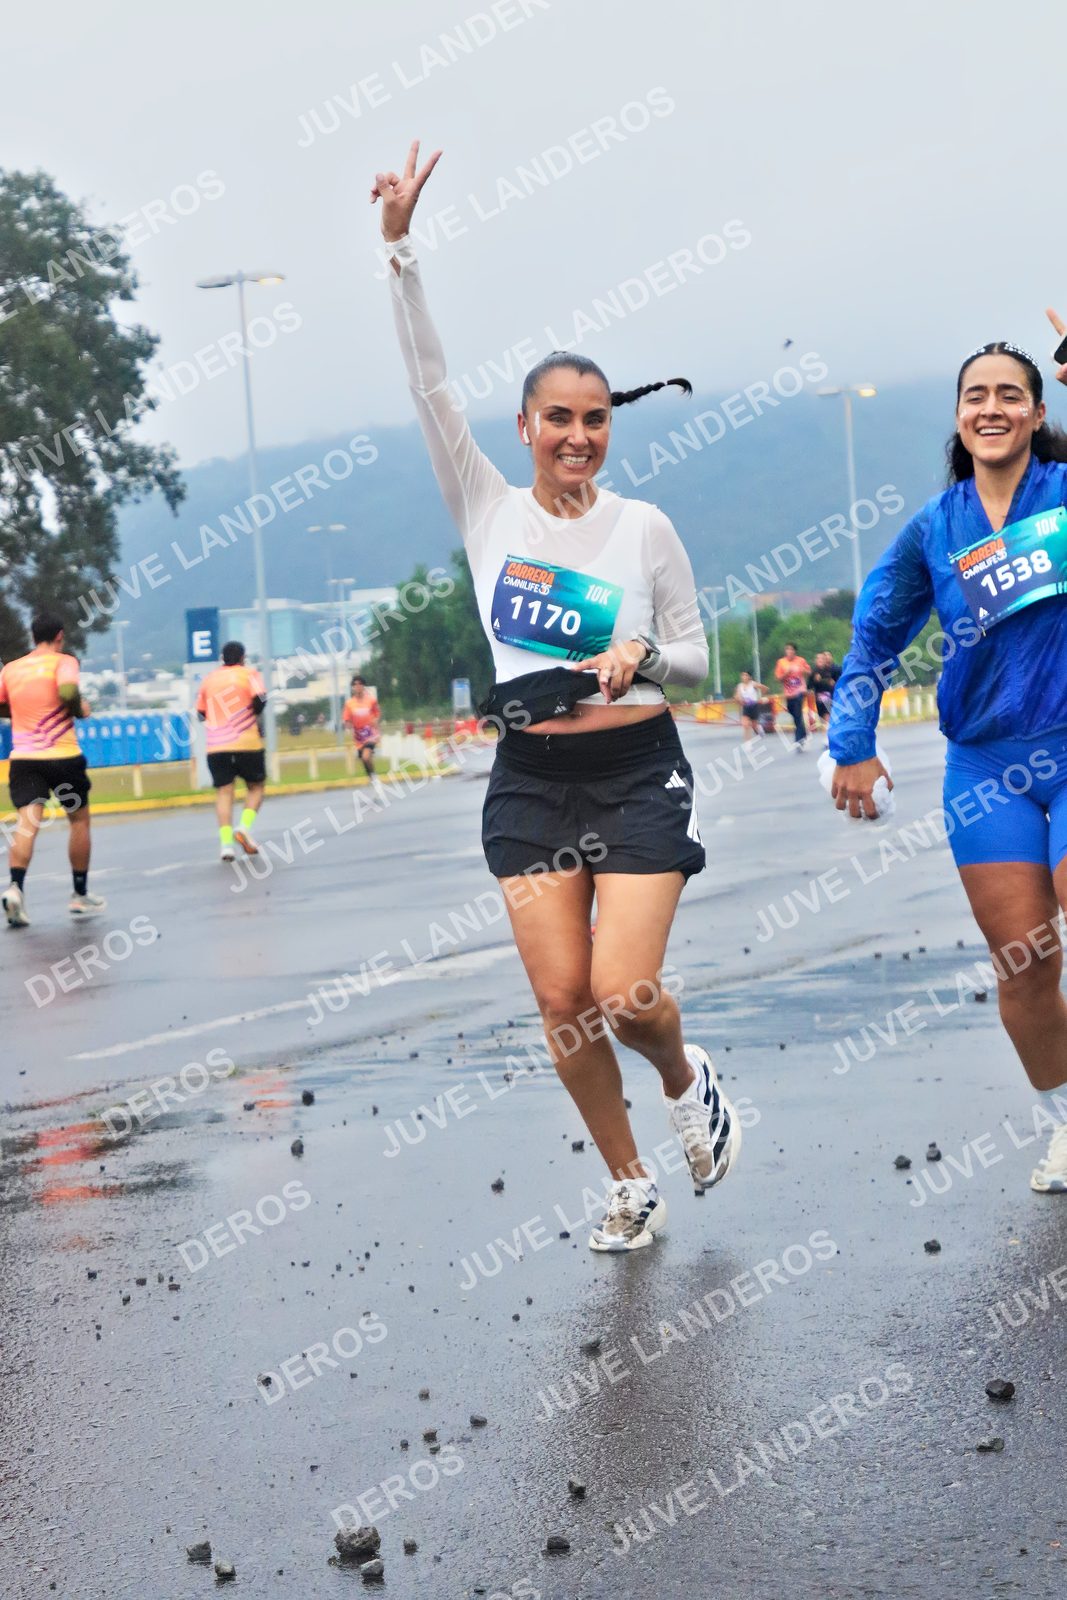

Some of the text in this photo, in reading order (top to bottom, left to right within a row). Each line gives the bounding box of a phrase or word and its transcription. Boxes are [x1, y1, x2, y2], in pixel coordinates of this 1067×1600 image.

[1034, 515, 1060, 538] 10K
[957, 537, 1005, 572] CARRERA
[506, 561, 555, 586] CARRERA
[980, 549, 1053, 597] 1538
[585, 583, 613, 606] 10K
[510, 595, 582, 636] 1170
[192, 630, 213, 657] E
